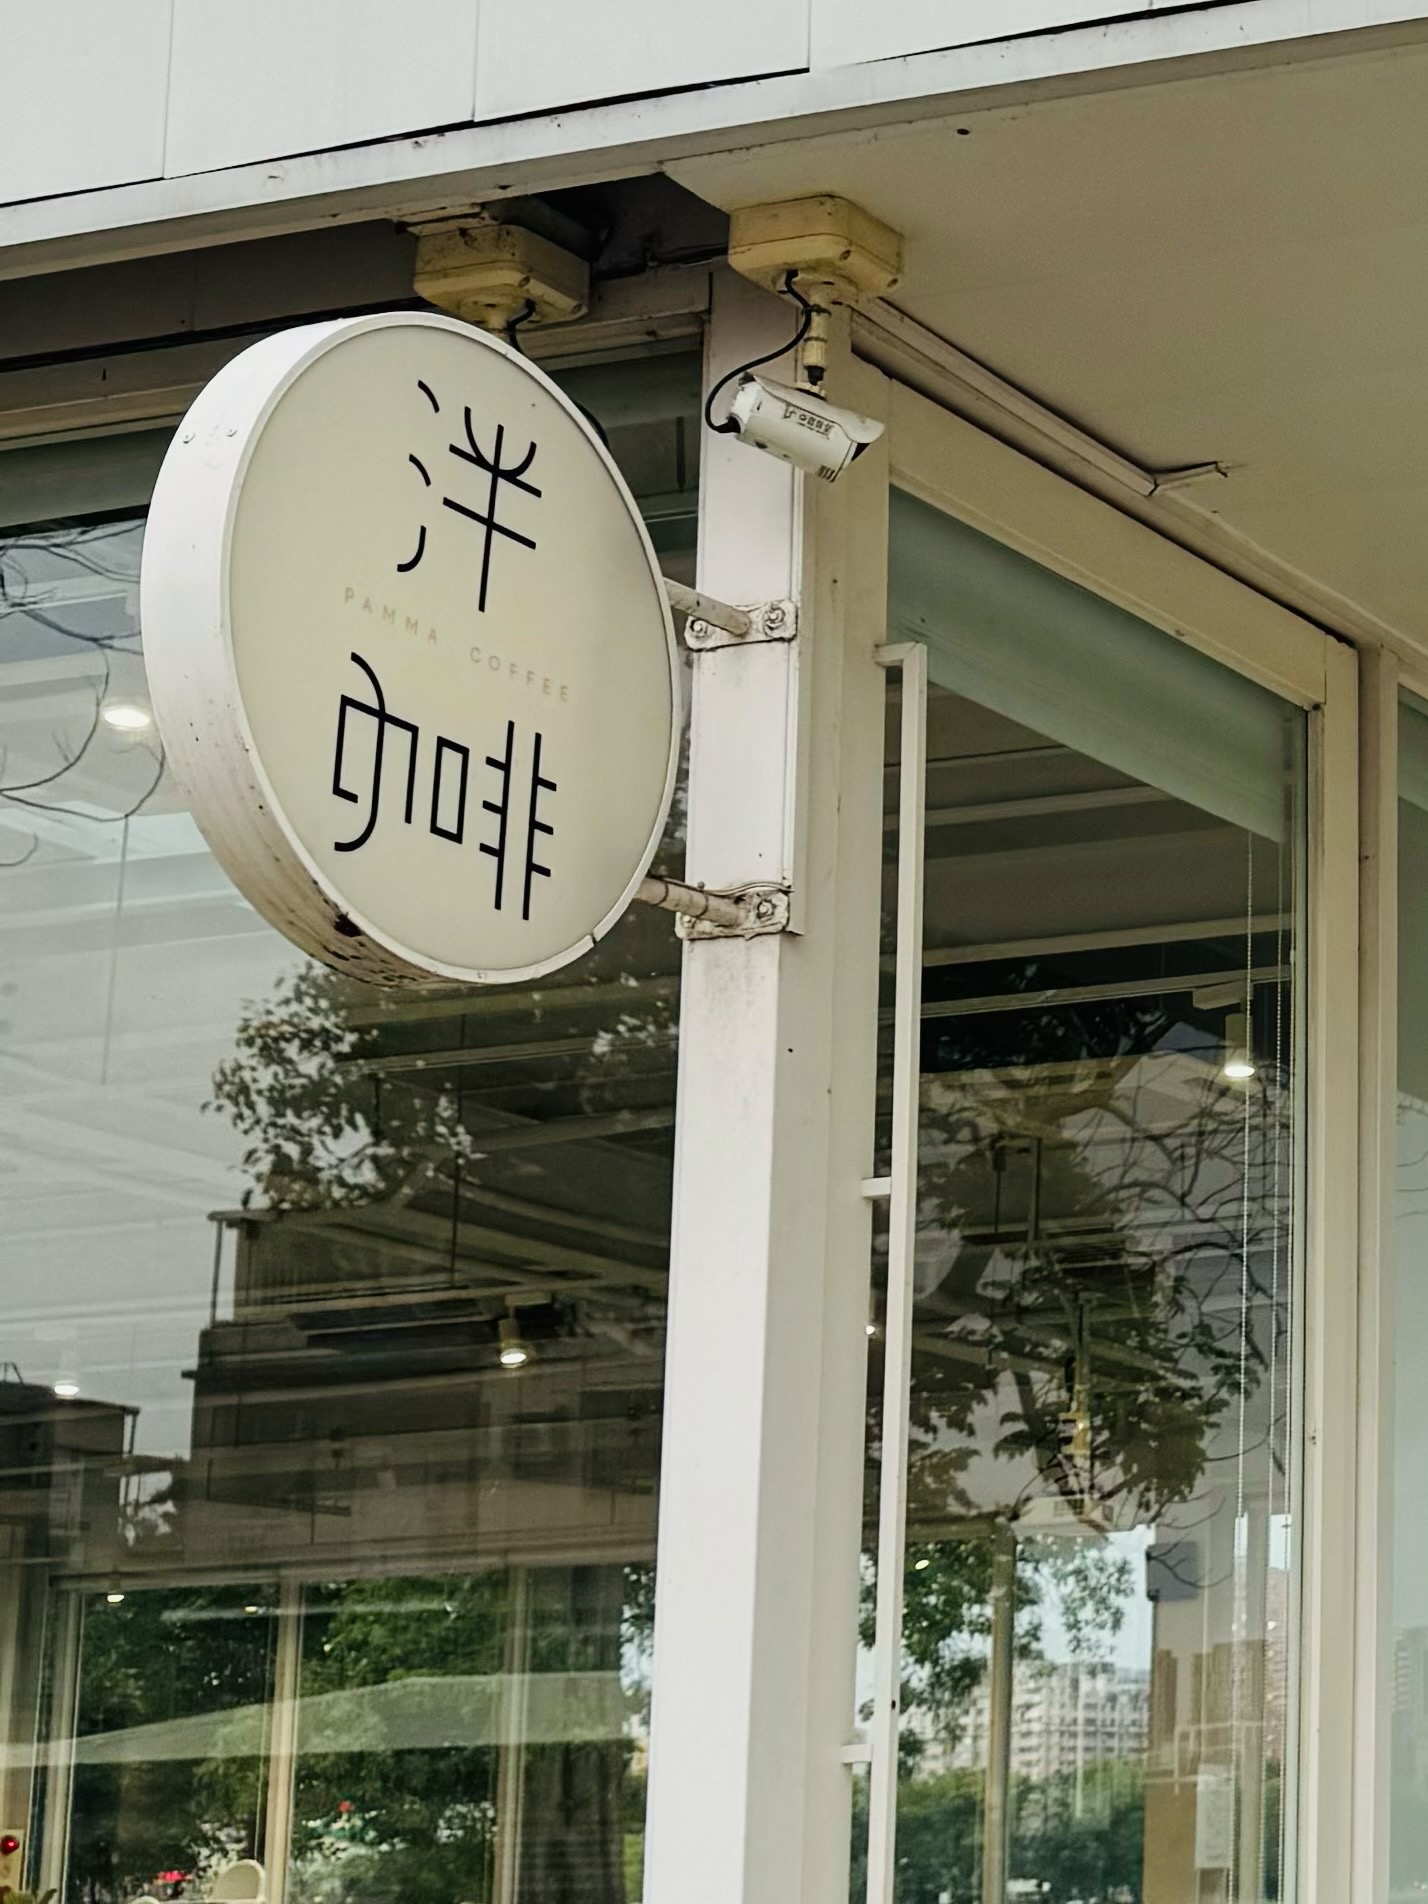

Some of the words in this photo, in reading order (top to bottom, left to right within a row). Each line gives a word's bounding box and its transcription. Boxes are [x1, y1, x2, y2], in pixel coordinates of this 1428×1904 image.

[343, 586, 438, 645] PAMMA
[469, 646, 569, 702] COFFEE
[332, 652, 557, 921] 咖啡
